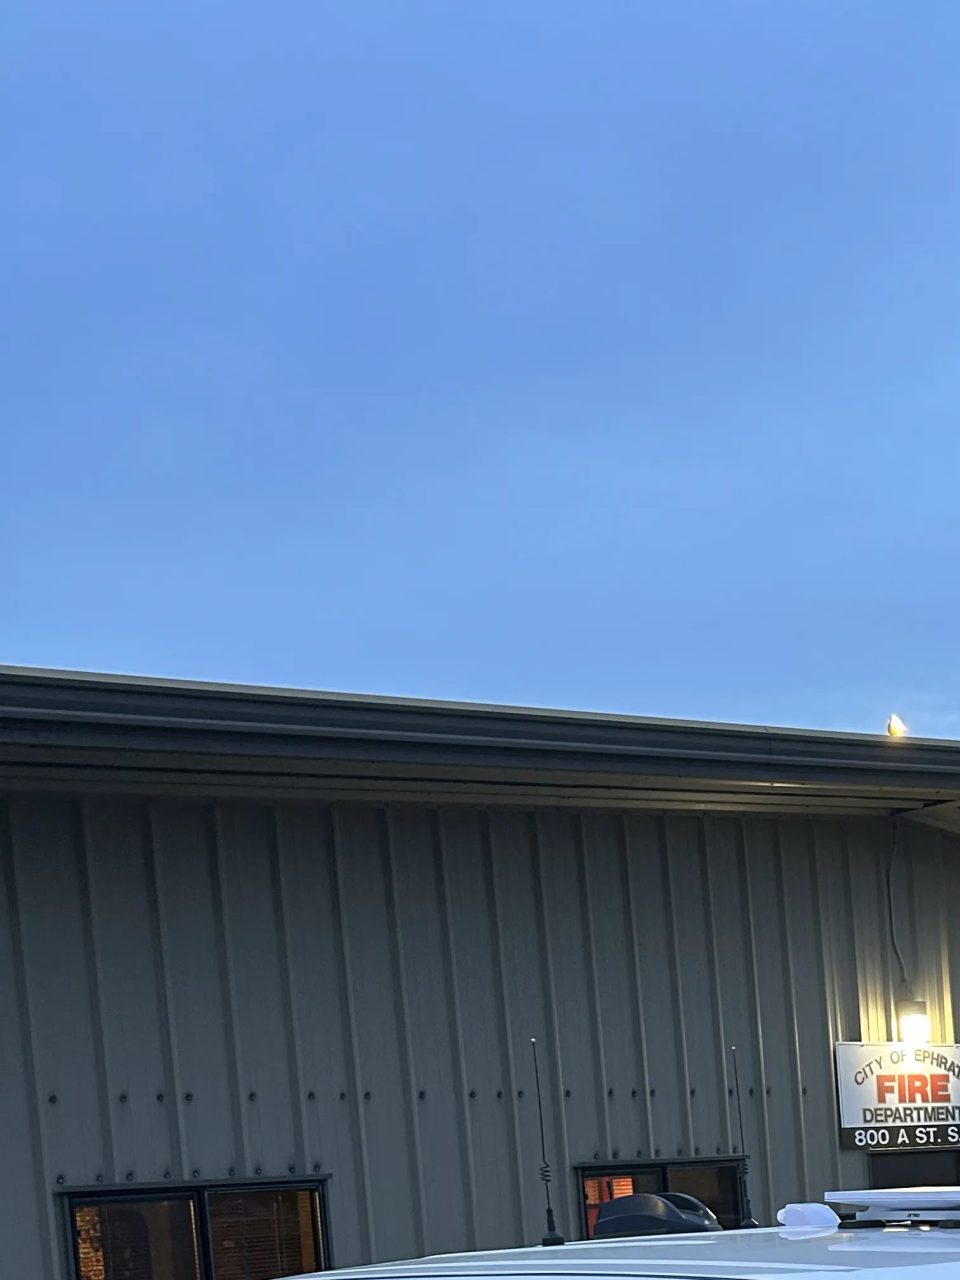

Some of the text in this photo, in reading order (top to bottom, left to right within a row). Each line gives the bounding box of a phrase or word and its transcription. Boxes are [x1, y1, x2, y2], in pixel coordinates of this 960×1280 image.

[854, 1056, 884, 1085] CITY
[890, 1049, 907, 1064] OF
[876, 1074, 951, 1104] FIRE
[855, 1129, 889, 1146] 800
[897, 1128, 909, 1144] A
[915, 1127, 941, 1143] ST.
